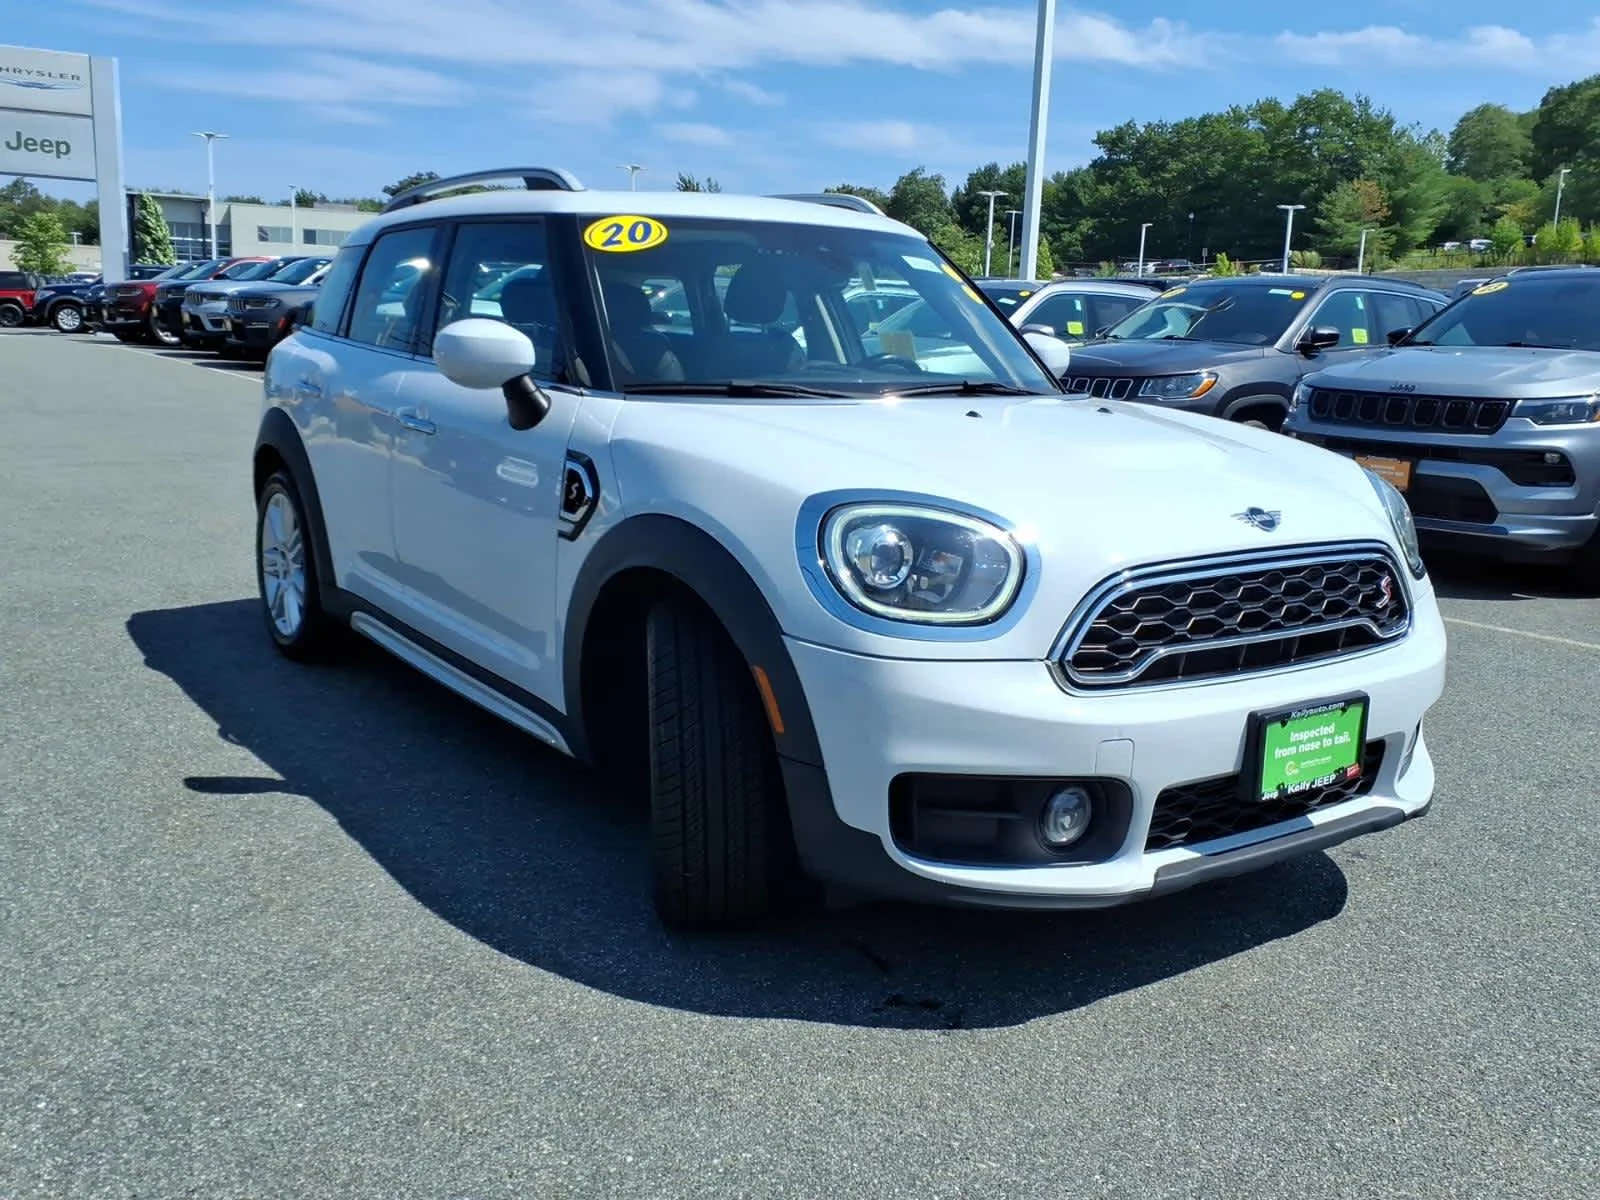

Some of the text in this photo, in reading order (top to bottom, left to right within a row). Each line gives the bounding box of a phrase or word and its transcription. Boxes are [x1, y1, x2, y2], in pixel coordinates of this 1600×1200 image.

[5, 131, 71, 158] Jeep
[602, 221, 652, 247] 20
[1290, 723, 1335, 742] Inspected
[1274, 747, 1297, 759] from
[1298, 741, 1321, 753] nose
[1322, 738, 1333, 749] to
[1312, 775, 1336, 787] JEEP
